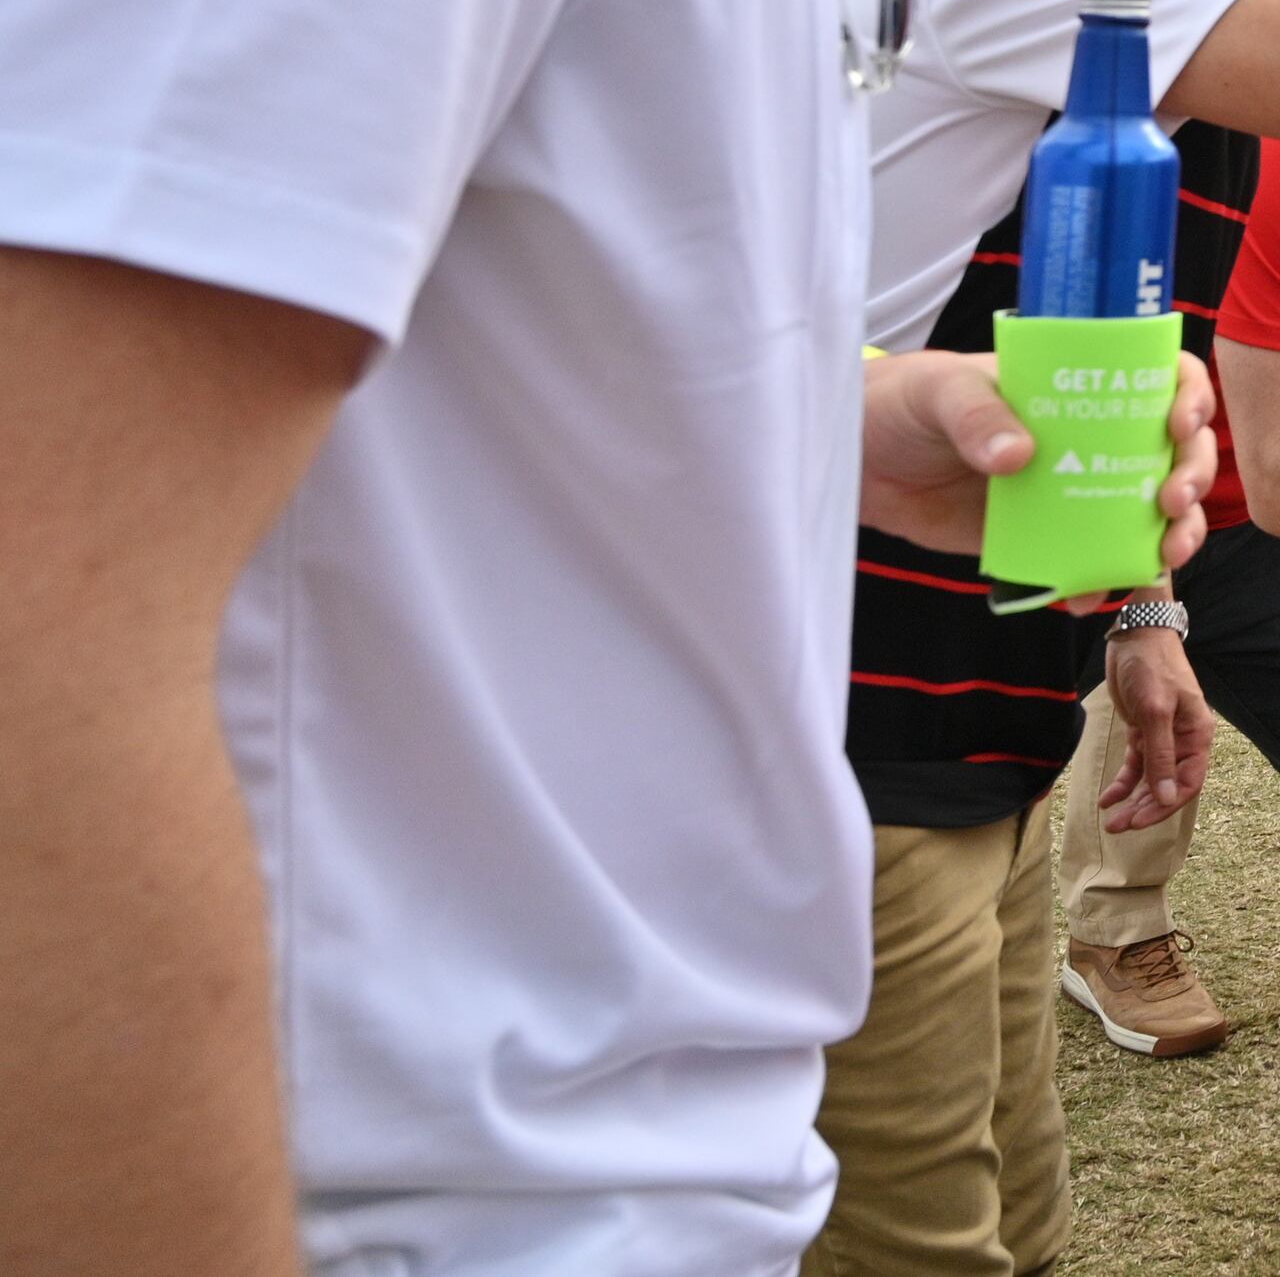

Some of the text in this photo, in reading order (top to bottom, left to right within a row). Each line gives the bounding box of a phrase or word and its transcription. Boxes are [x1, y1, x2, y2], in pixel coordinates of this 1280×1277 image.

[1053, 367, 1105, 392] GET
[1110, 369, 1129, 392] A
[1065, 396, 1126, 419] YOUR
